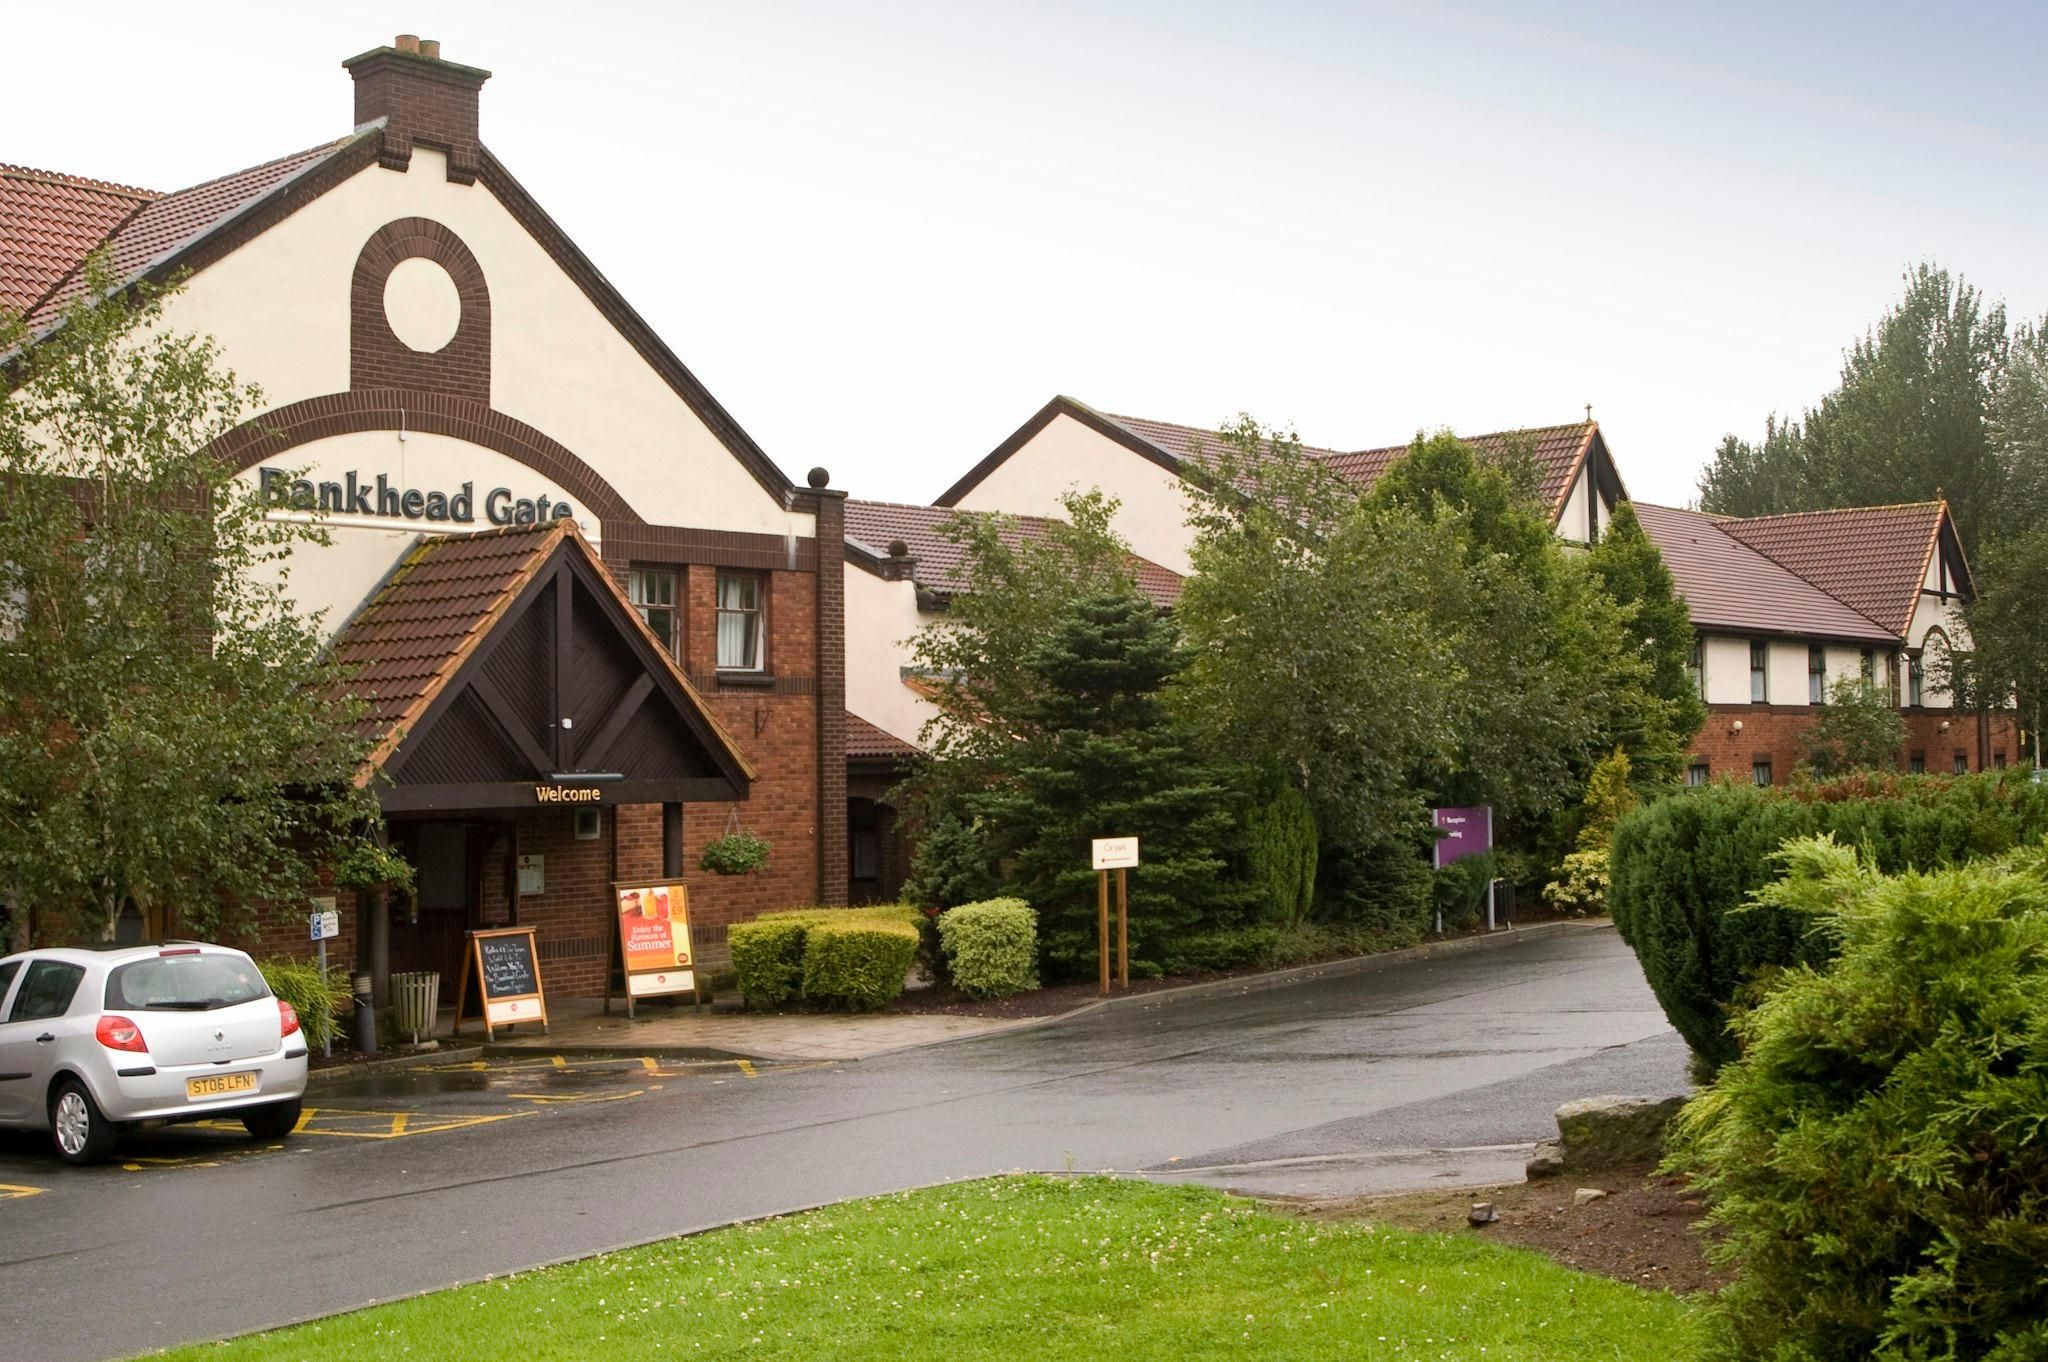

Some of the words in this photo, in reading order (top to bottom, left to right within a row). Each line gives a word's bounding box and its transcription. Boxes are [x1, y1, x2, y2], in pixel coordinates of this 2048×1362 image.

[260, 467, 475, 523] Bankhead
[487, 487, 573, 525] Gate
[536, 785, 601, 802] Welcome
[314, 916, 320, 926] P
[626, 940, 672, 952] Summer
[193, 1079, 225, 1094] ST06
[228, 1074, 251, 1089] LFN
